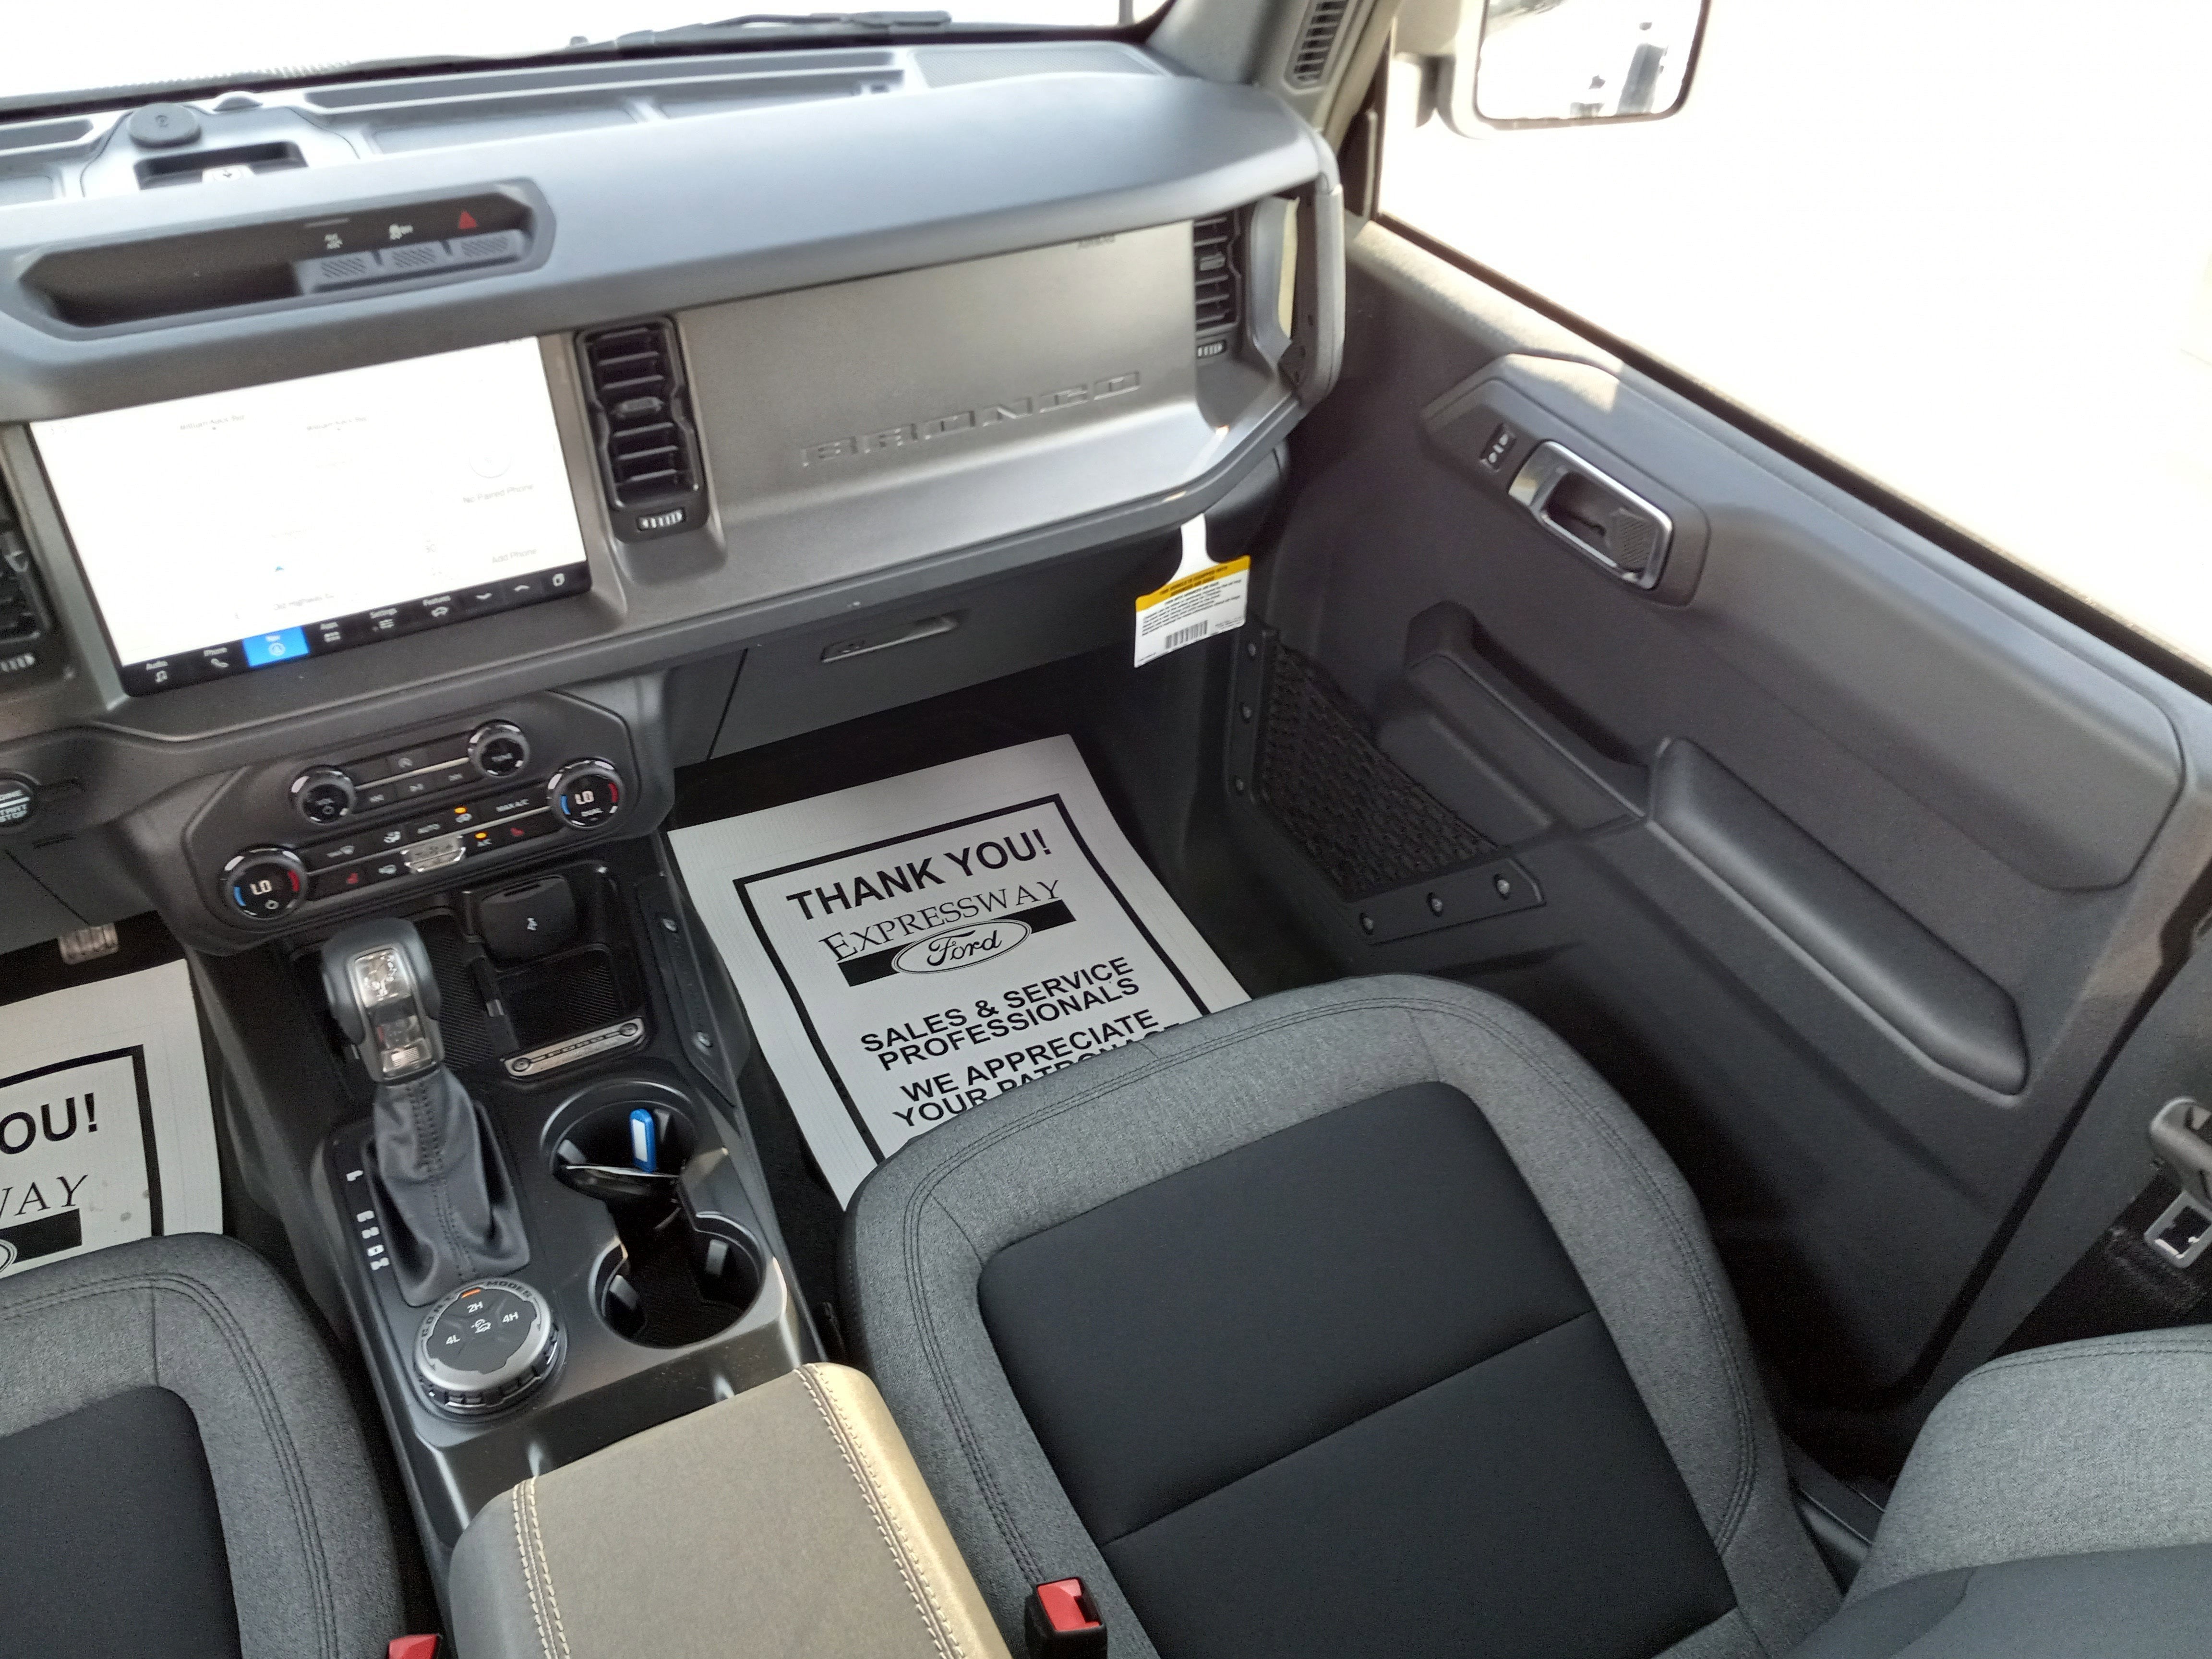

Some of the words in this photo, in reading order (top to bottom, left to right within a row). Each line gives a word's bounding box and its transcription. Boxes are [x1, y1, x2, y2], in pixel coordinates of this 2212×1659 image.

[801, 371, 1140, 467] BRONCO
[786, 857, 946, 920] THANK
[944, 828, 1052, 877] YOU!
[818, 879, 1059, 962] EXPRESSWAY
[926, 929, 1002, 966] Ford
[860, 1008, 967, 1052] SALES
[974, 999, 999, 1018] &
[1003, 956, 1134, 1009] SERVICE
[878, 977, 1140, 1071] PROFESSIONALS
[900, 1072, 959, 1103] WE
[967, 1009, 1159, 1086] APPRECIATE
[0, 1092, 98, 1154] OU!
[892, 1088, 989, 1127] YOUR
[445, 1334, 461, 1345] 4L
[467, 1301, 484, 1313] 2H
[502, 1311, 519, 1323] 4H
